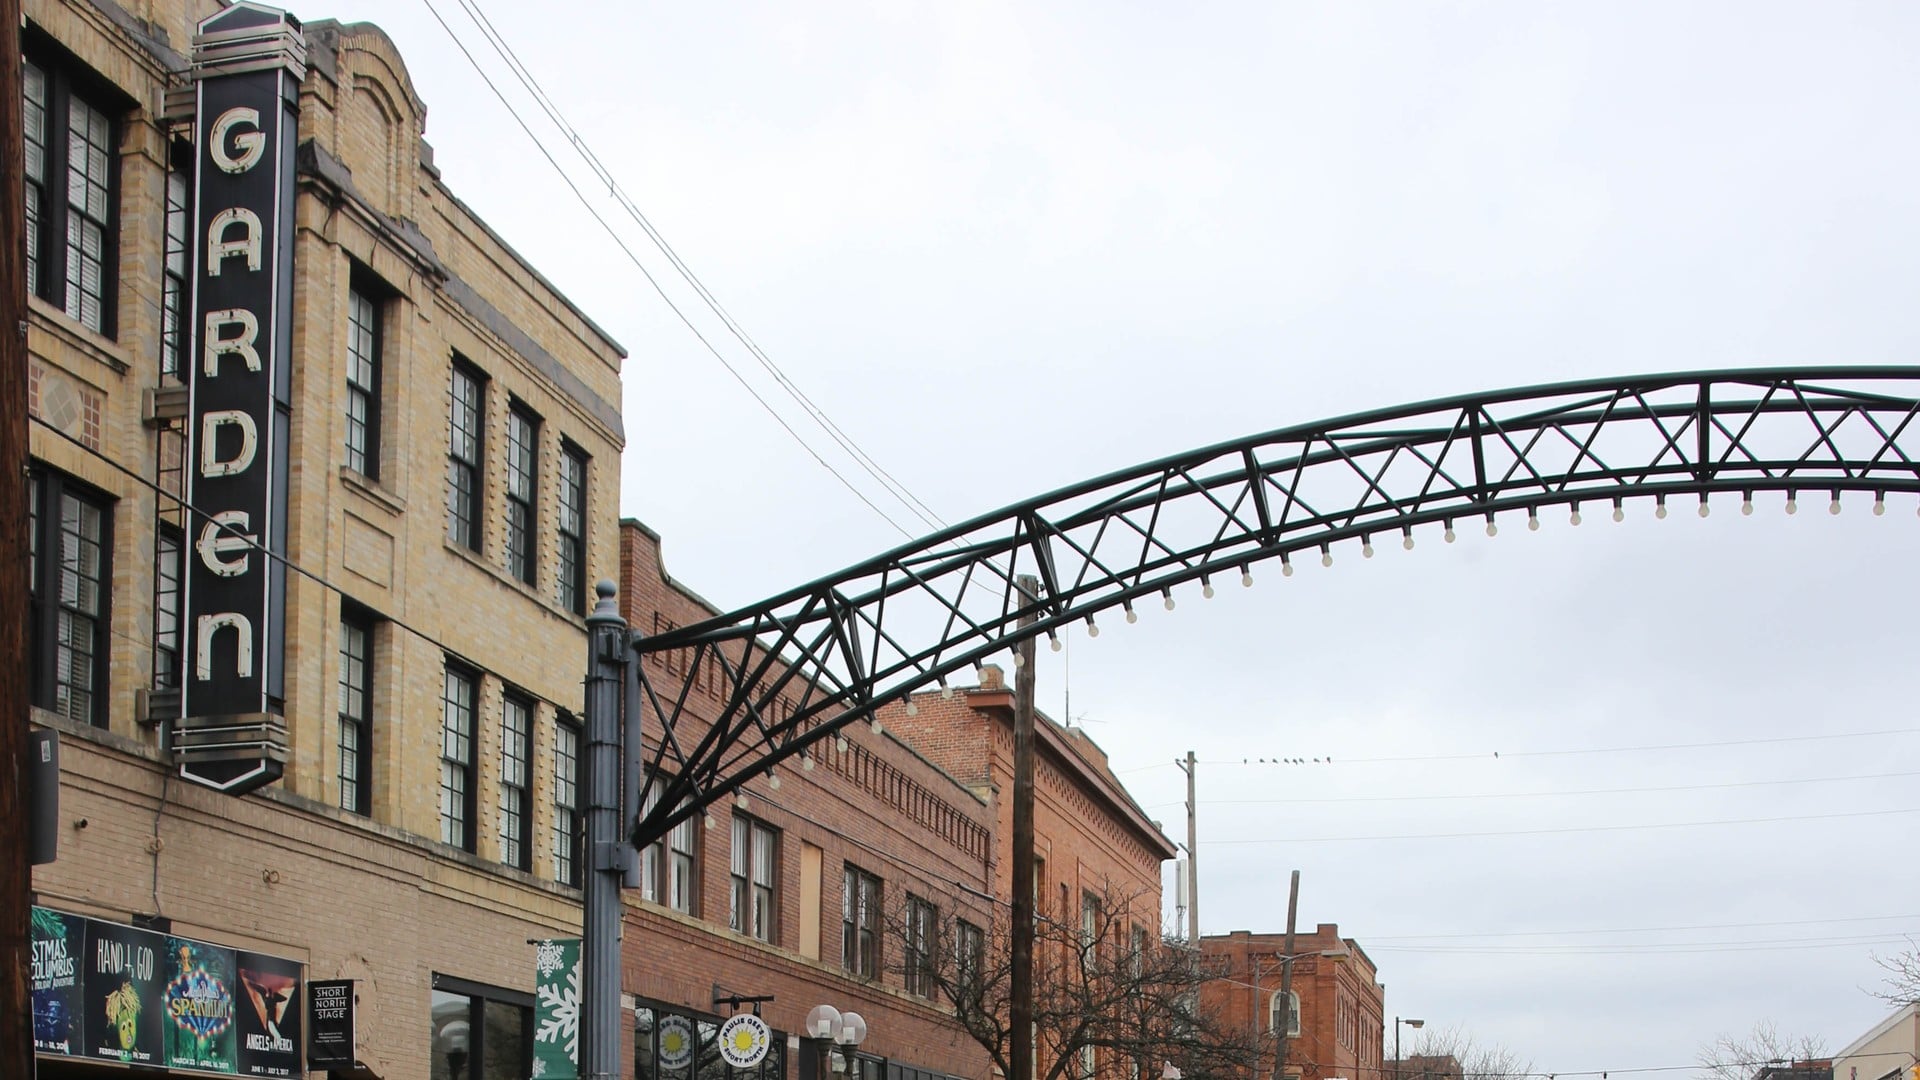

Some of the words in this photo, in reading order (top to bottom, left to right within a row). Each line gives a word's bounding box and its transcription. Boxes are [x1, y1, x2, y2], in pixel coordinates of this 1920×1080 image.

[31, 938, 67, 962] STMAS
[97, 938, 123, 974] HAND
[137, 945, 154, 981] GOD
[316, 987, 345, 998] SHORT
[316, 998, 346, 1008] NORTH
[318, 1010, 344, 1019] STAGE
[723, 1018, 745, 1037] PAULIE
[747, 1018, 764, 1035] GEE'S
[246, 1033, 270, 1051] ANGELS
[98, 1047, 123, 1057] FEBRUARY
[724, 1047, 743, 1063] SHORT
[744, 1046, 764, 1064] NORTH
[171, 1056, 189, 1065] MARCH
[200, 1059, 212, 1068] APRIL
[251, 1065, 261, 1073] JUNE
